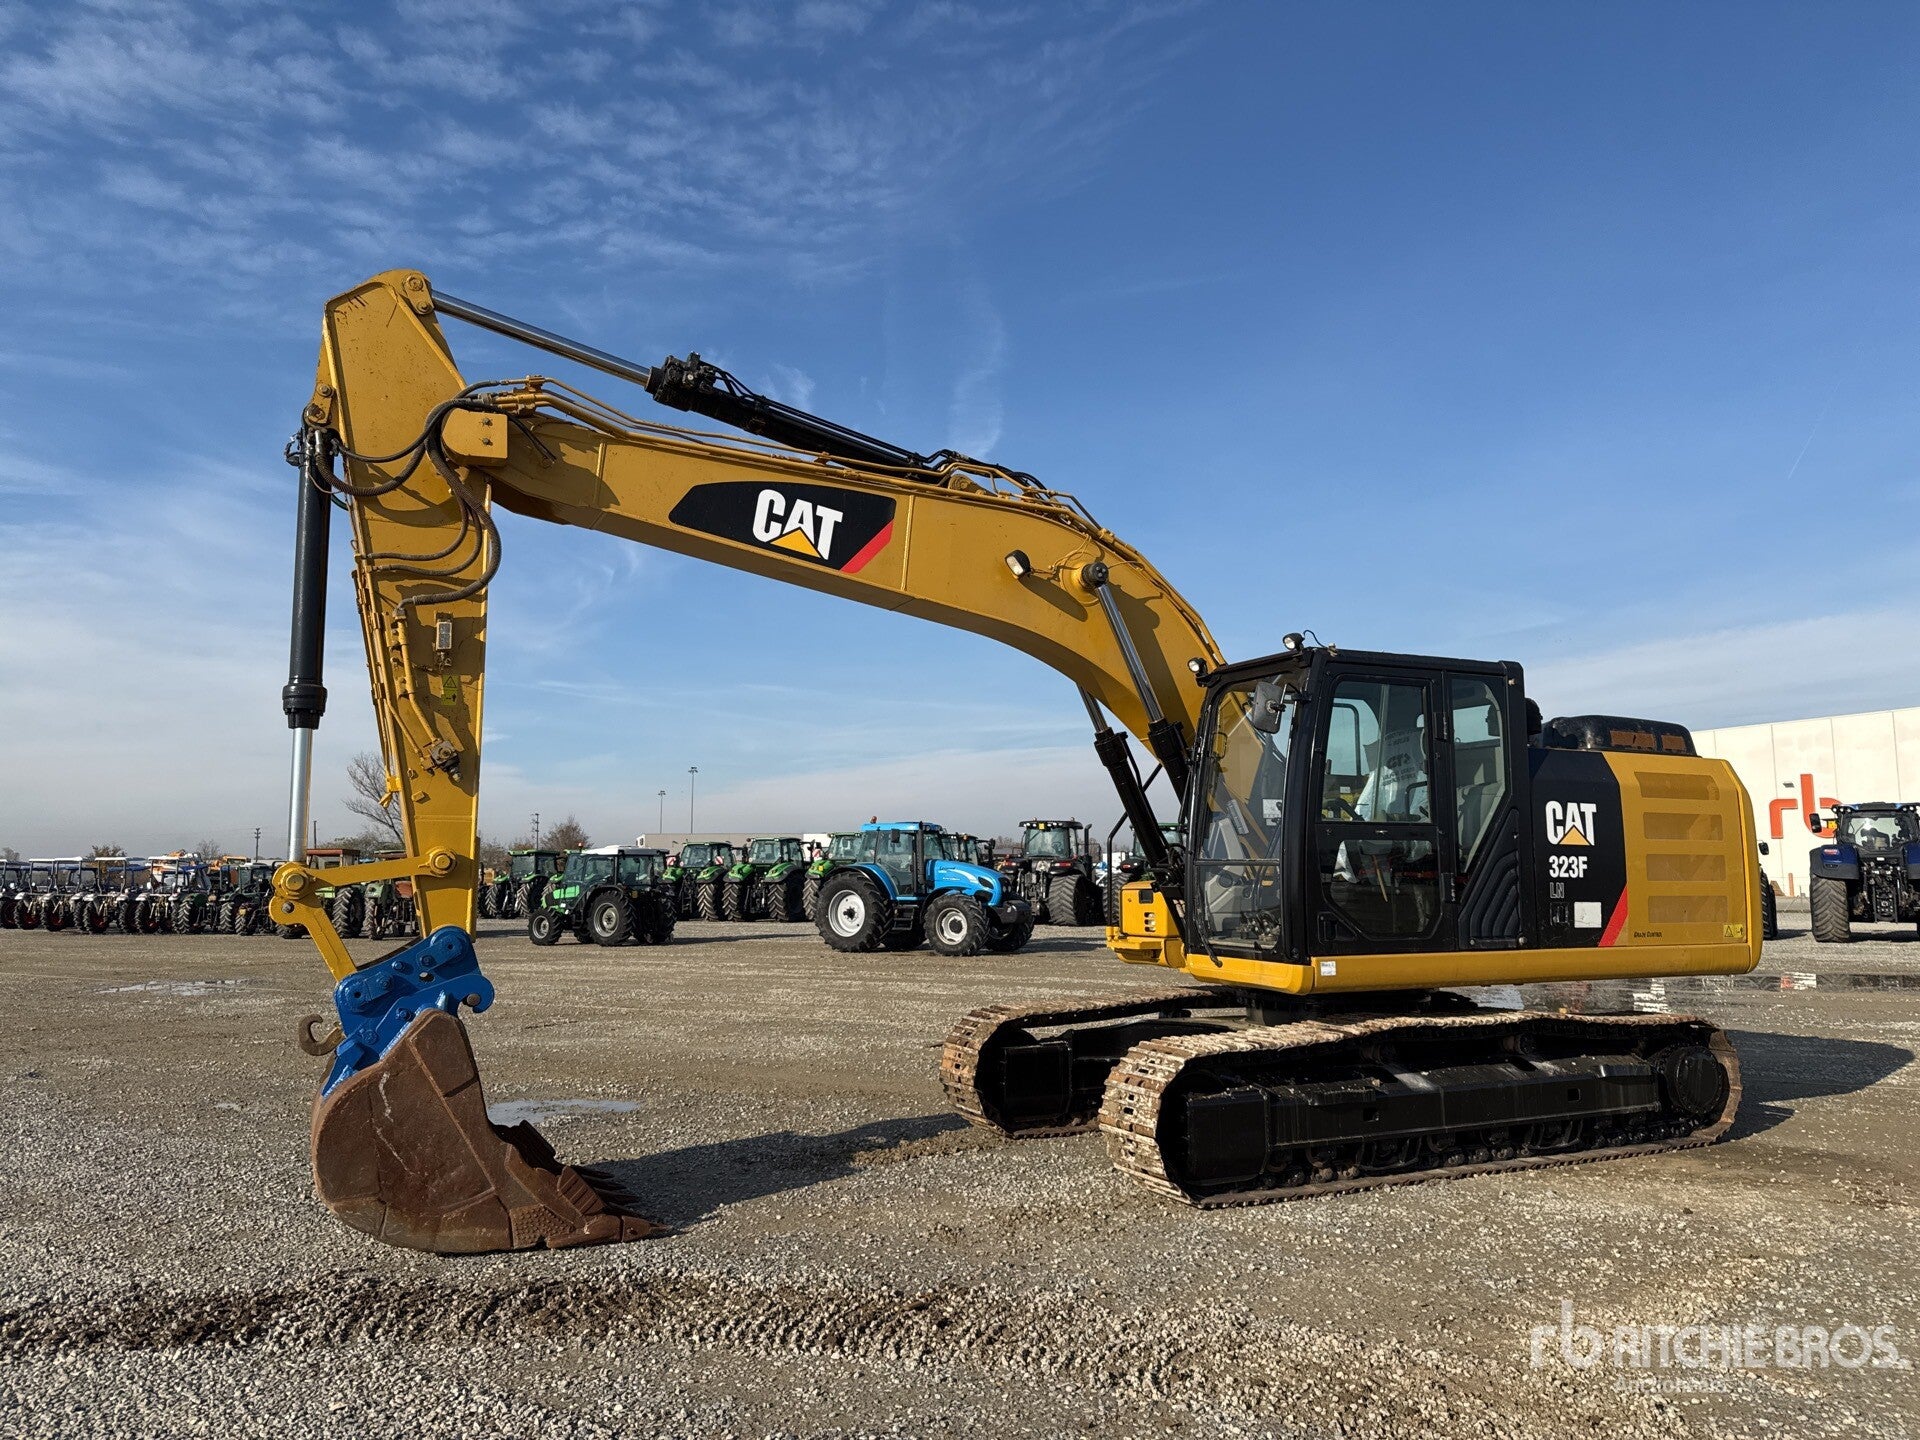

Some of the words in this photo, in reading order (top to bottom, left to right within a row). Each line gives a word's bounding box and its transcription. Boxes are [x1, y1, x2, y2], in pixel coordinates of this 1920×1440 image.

[753, 489, 843, 560] CAT
[1545, 800, 1597, 846] CAT
[1549, 855, 1588, 878] 323F
[1549, 882, 1565, 899] LN
